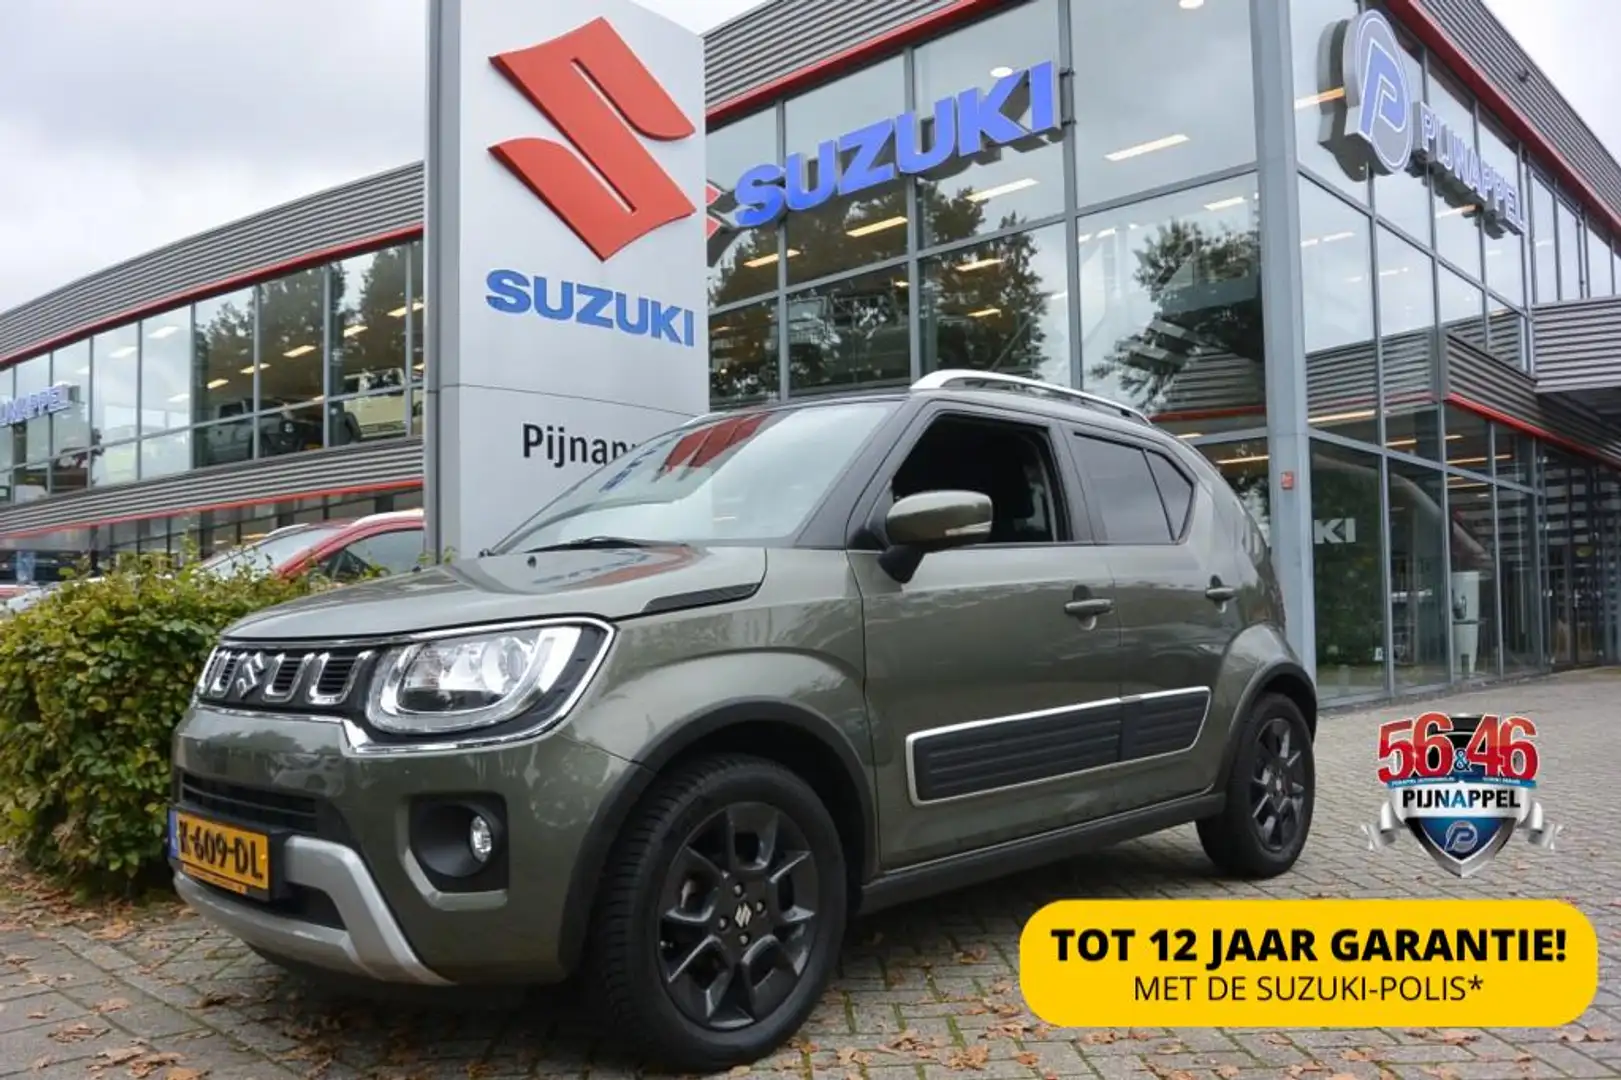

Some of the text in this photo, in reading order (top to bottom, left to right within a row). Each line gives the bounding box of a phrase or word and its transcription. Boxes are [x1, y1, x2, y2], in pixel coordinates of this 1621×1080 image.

[734, 60, 1056, 227] SUZUKI
[1420, 101, 1526, 234] PIJNAPPEL
[485, 269, 695, 347] SUZUKI
[523, 422, 637, 468] Pijnap
